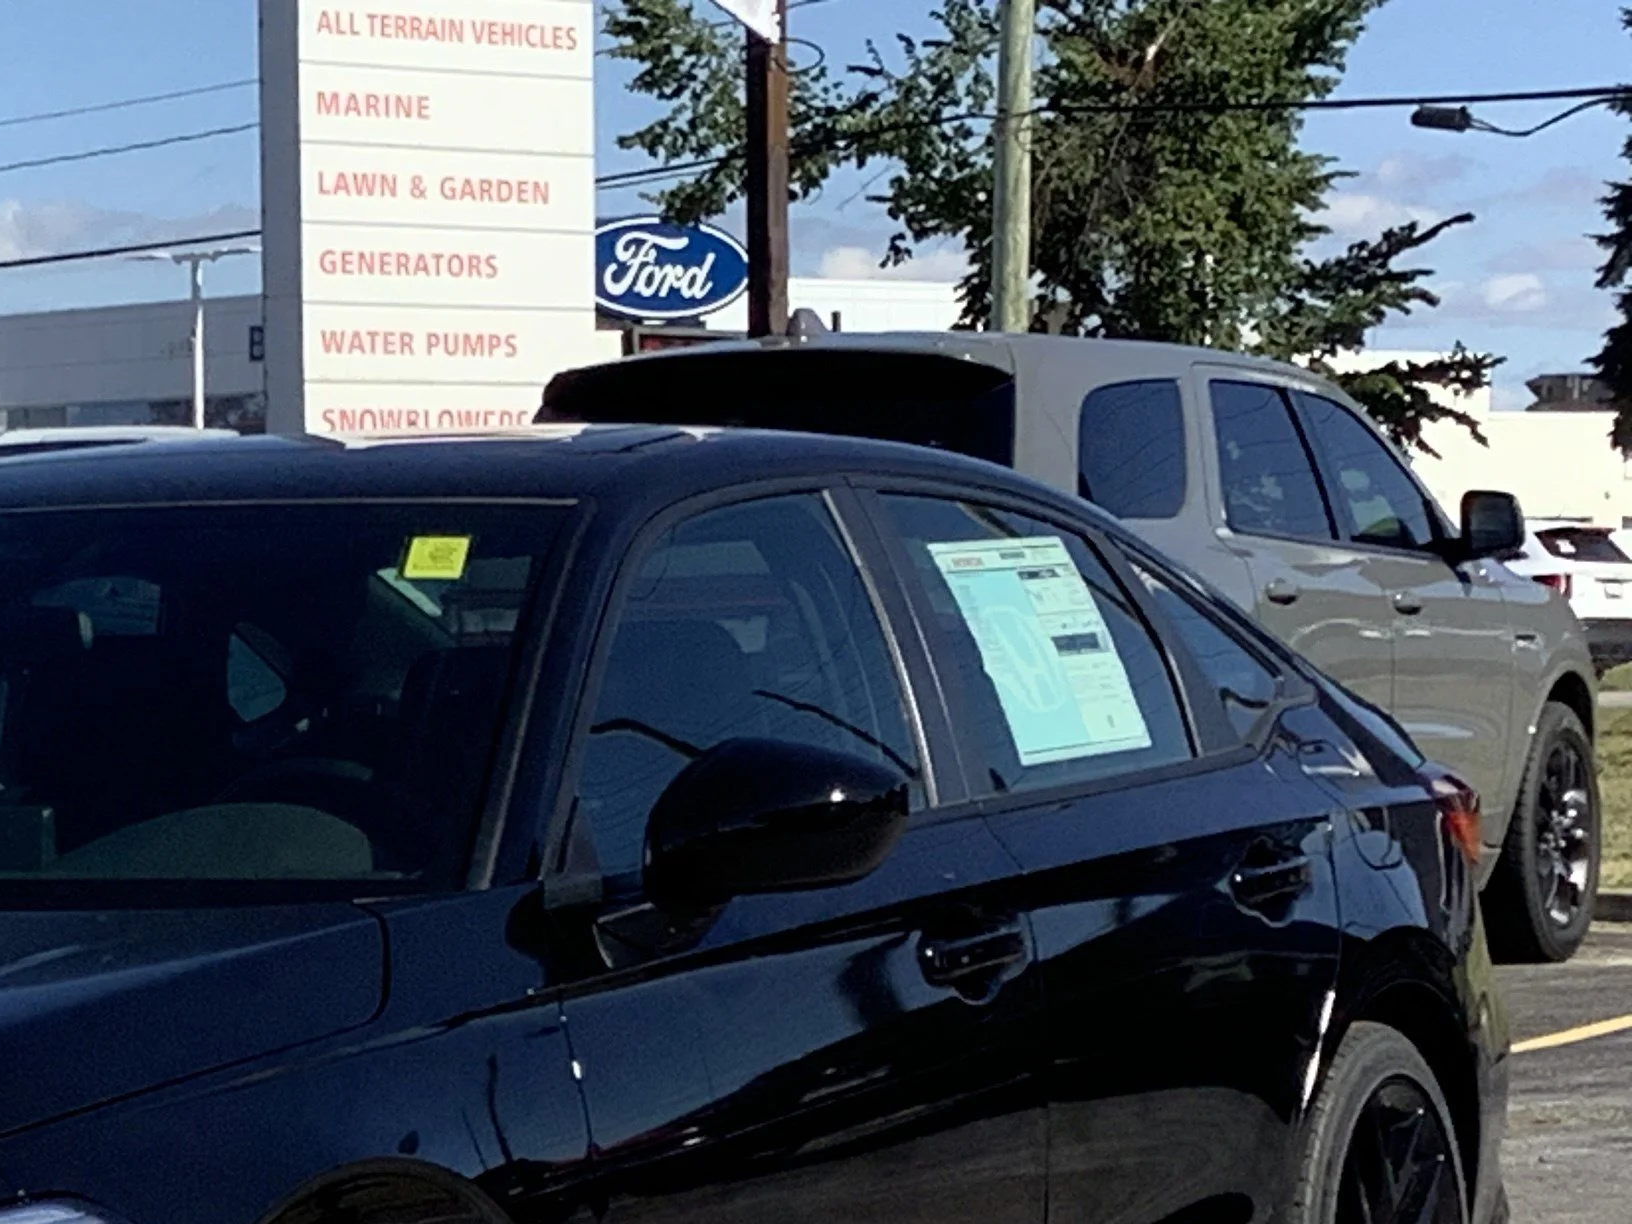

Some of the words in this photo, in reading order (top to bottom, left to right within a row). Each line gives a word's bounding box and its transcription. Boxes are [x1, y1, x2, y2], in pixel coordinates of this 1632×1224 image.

[317, 10, 360, 36] ALL
[366, 13, 464, 43] TERRAIN
[472, 19, 577, 50] VEHICLES
[316, 91, 430, 119] MARINE
[318, 171, 397, 197] LAWN
[410, 175, 427, 199] &
[440, 176, 549, 204] GARDEN
[319, 250, 498, 279] GENERATORS
[603, 231, 715, 299] Ford
[321, 330, 415, 355] WATER
[427, 332, 518, 357] PUMPS
